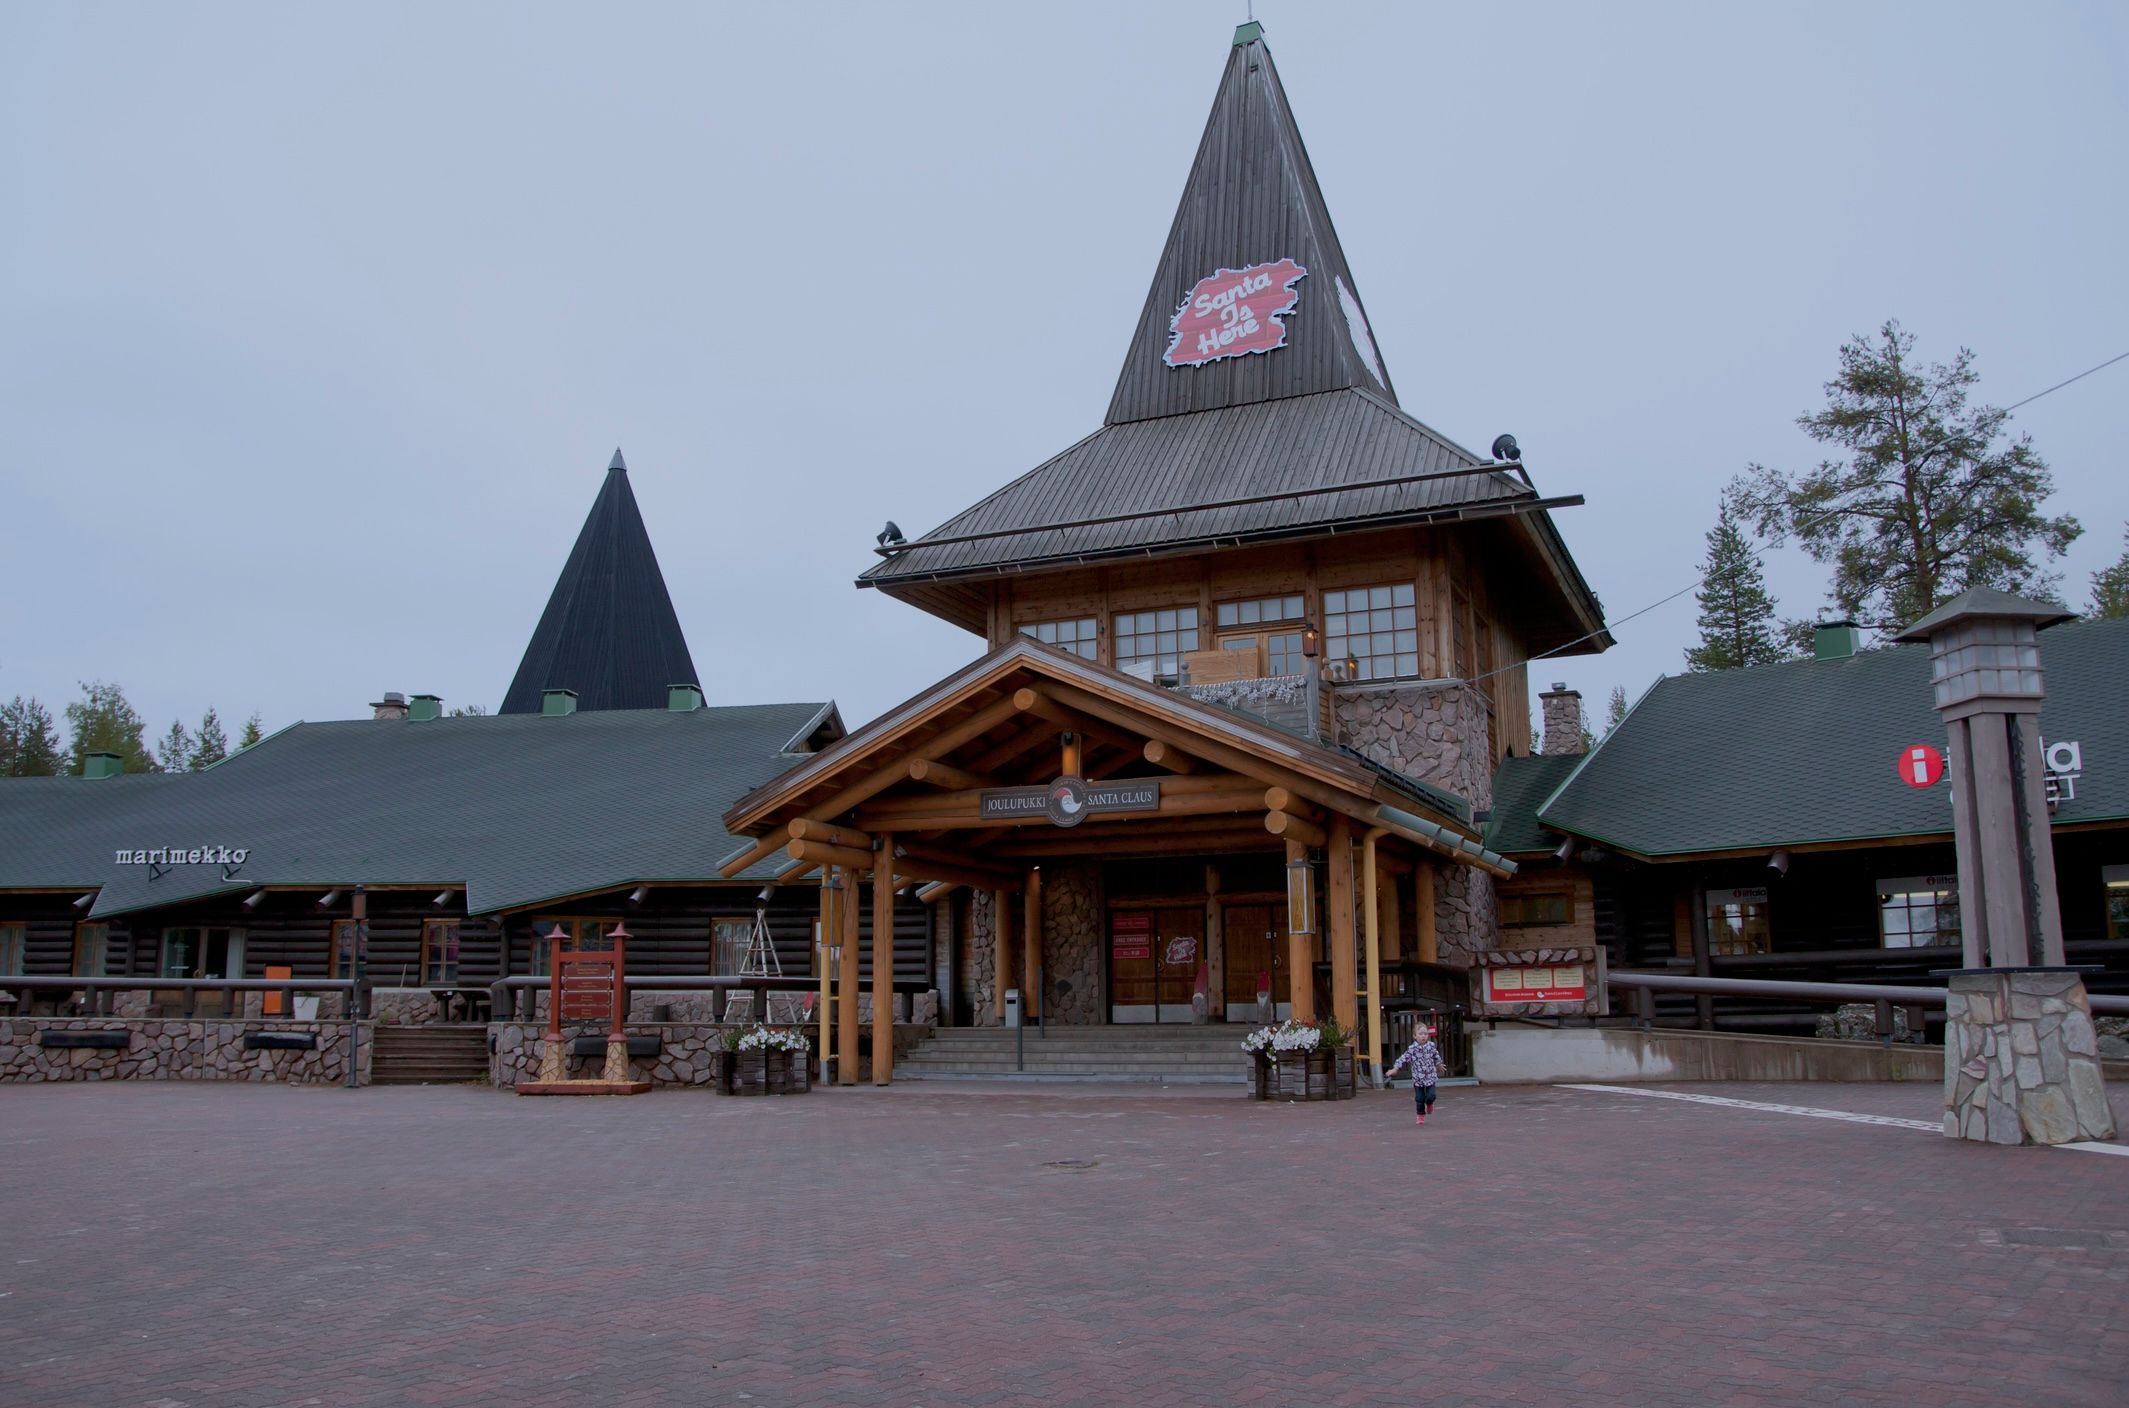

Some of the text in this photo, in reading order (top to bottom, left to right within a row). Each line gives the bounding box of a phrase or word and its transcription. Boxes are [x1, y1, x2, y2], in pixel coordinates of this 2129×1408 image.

[1194, 271, 1272, 318] Santa
[1220, 303, 1255, 329] Is
[1197, 316, 1260, 355] Here
[987, 796, 1046, 812] JOULUPUKKI
[1087, 791, 1152, 806] SANTA CLAUS
[115, 845, 249, 864] marimekko
